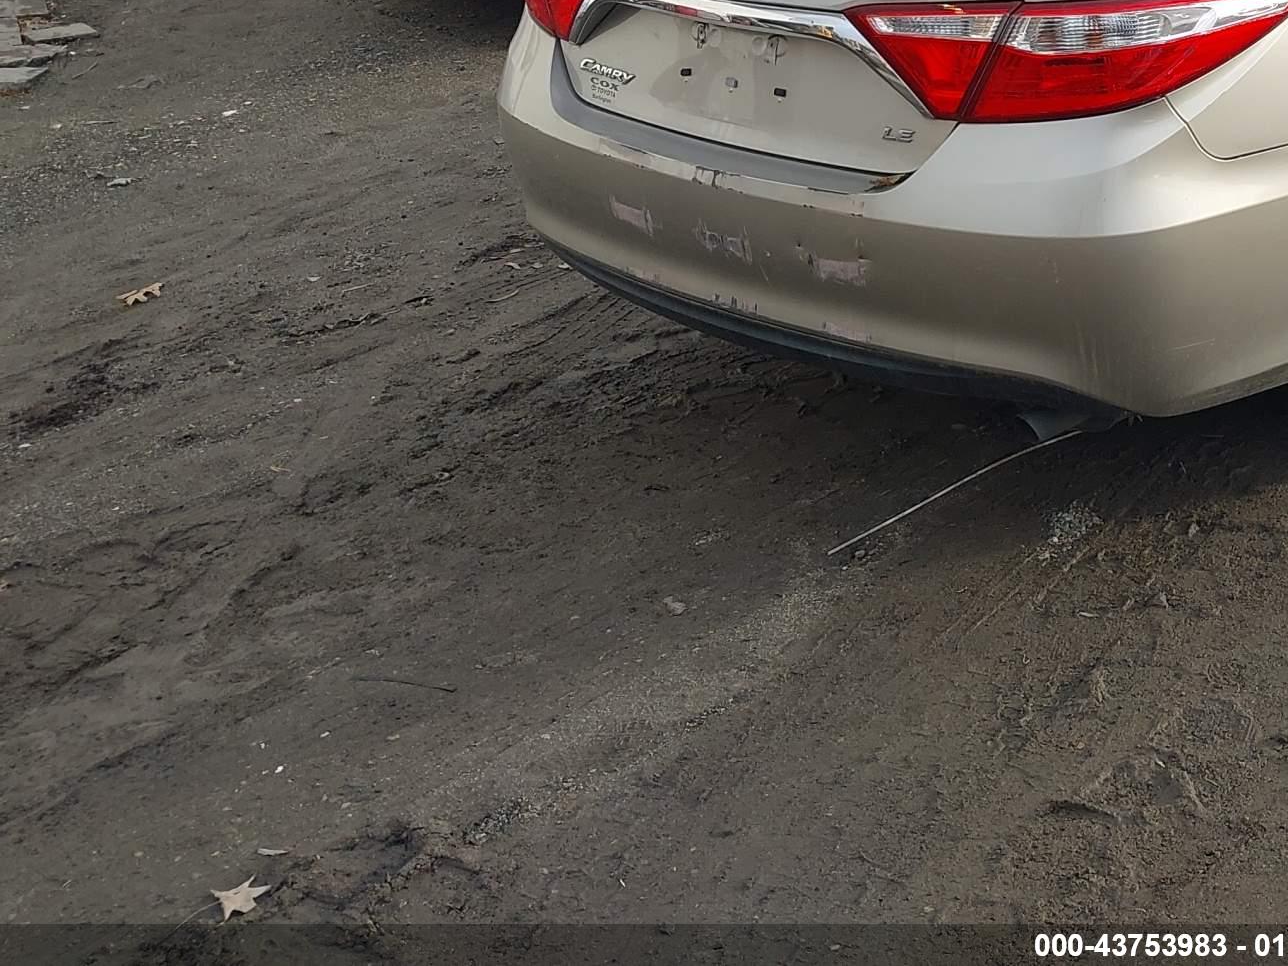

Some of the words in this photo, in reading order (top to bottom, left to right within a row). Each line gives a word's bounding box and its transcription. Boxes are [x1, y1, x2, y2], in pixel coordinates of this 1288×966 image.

[580, 58, 636, 85] CAMRY
[590, 77, 620, 92] COX
[882, 126, 916, 143] LE
